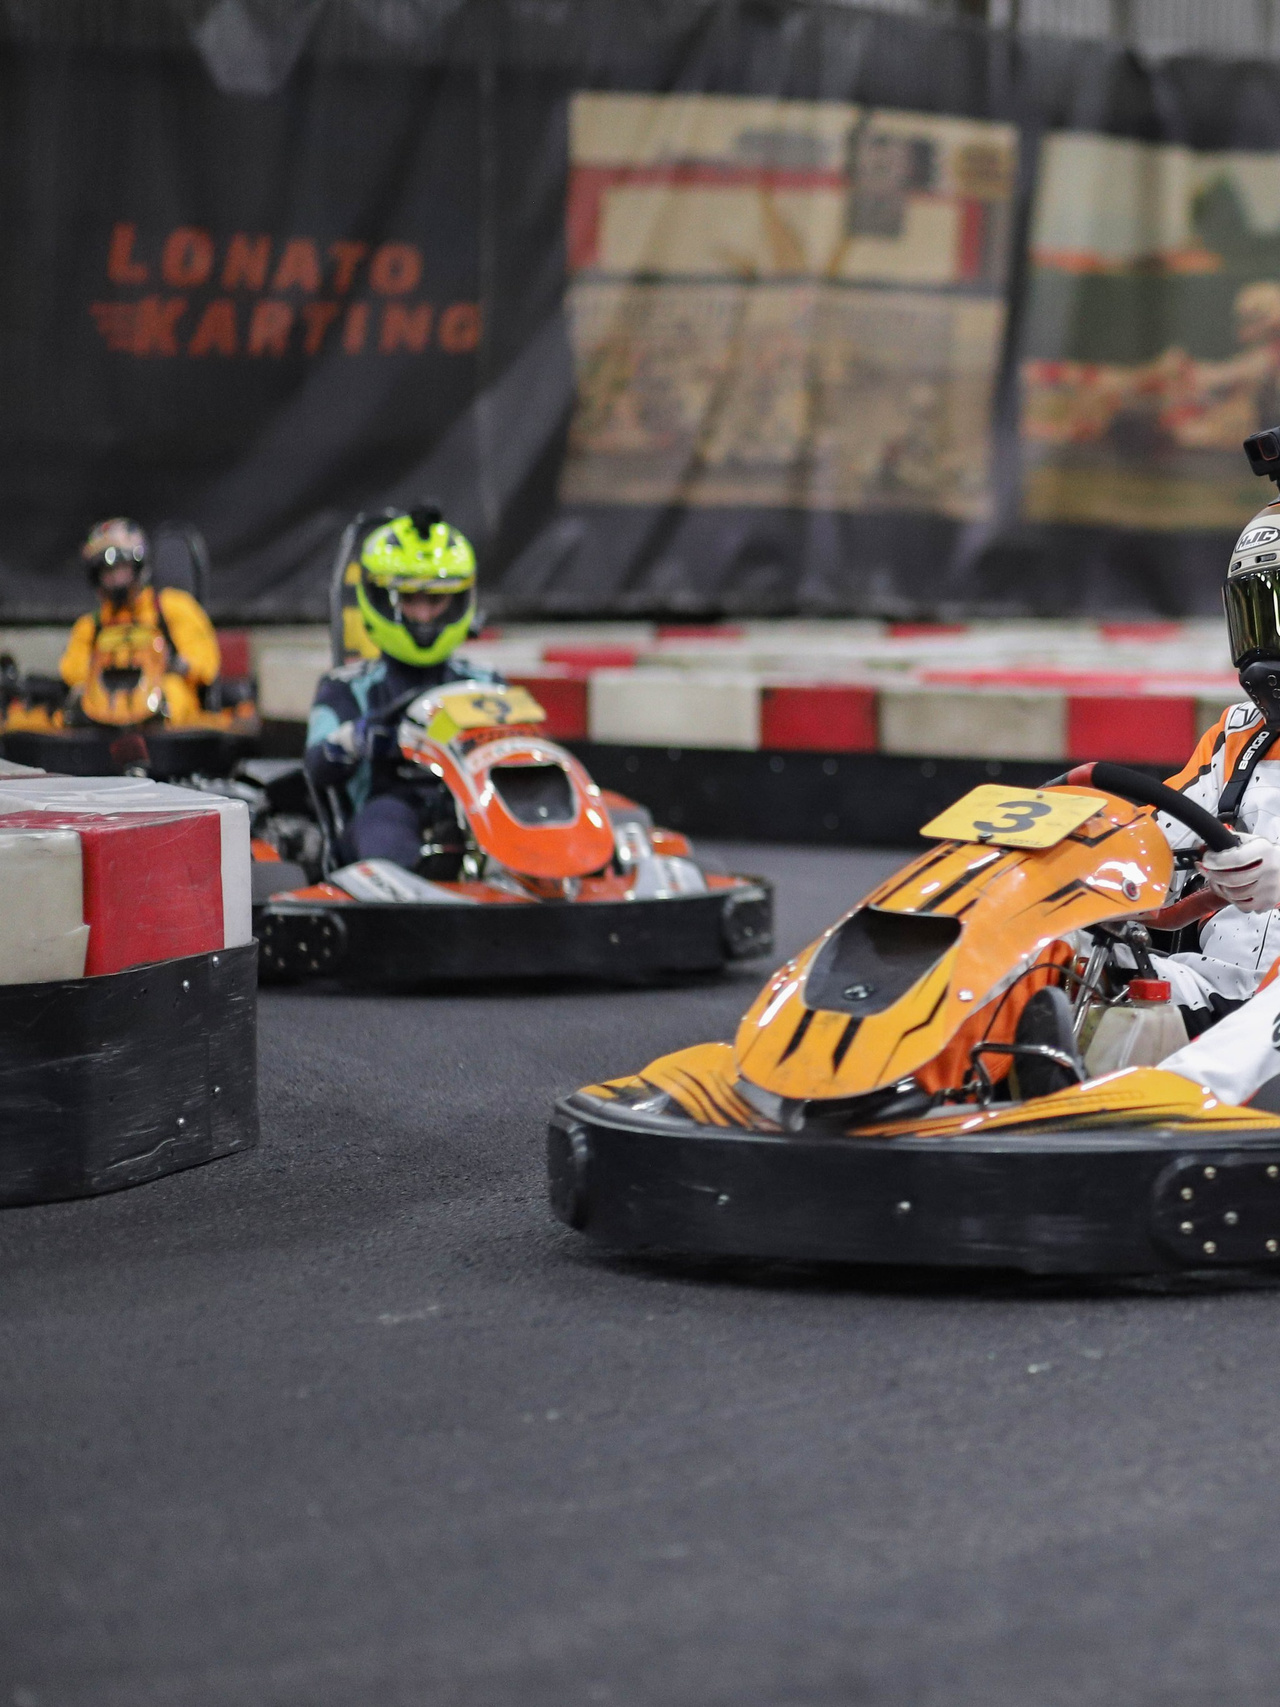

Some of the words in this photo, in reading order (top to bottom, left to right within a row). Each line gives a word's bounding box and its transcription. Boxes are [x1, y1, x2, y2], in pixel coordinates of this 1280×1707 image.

[107, 222, 425, 295] LONATO
[133, 294, 483, 357] KARTING
[1238, 530, 1276, 549] HJC
[1238, 731, 1270, 770] BENGIO
[973, 800, 1052, 833] 3
